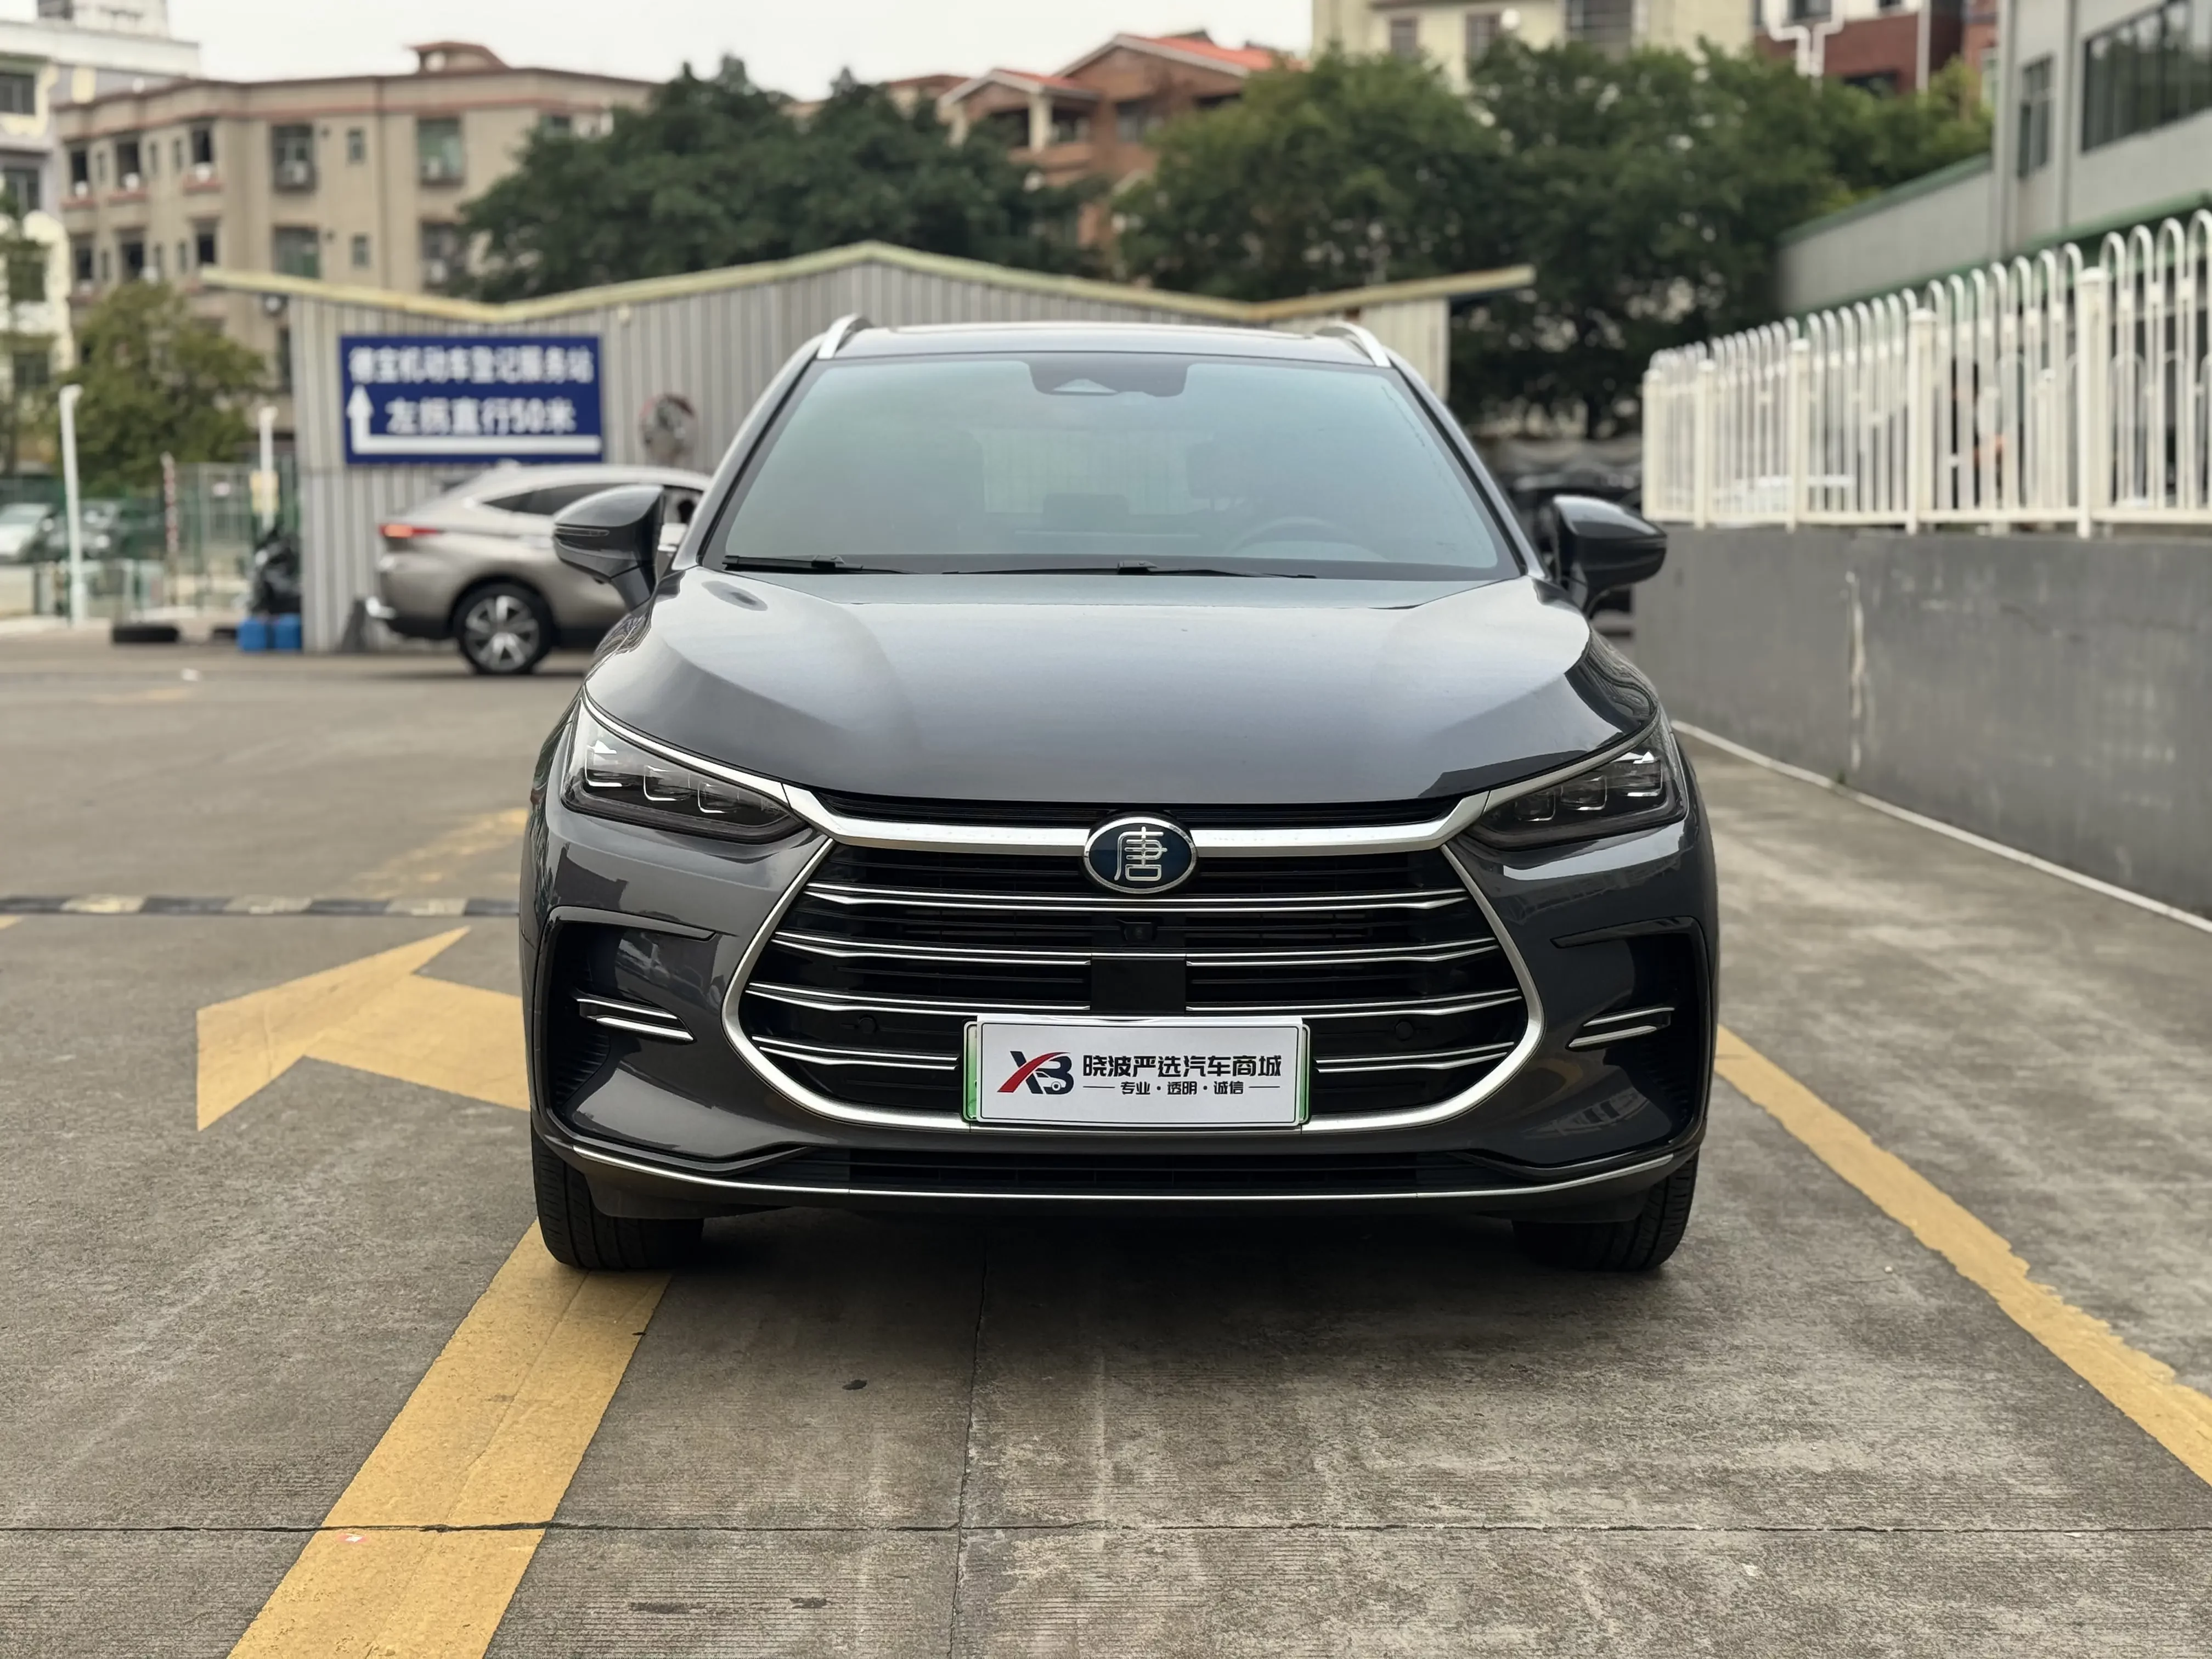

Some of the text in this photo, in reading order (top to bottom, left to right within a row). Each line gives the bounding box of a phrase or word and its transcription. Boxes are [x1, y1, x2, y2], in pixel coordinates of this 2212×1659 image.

[1114, 826, 1167, 881] 唐
[1083, 1055, 1282, 1077] 晓波严选汽车商城
